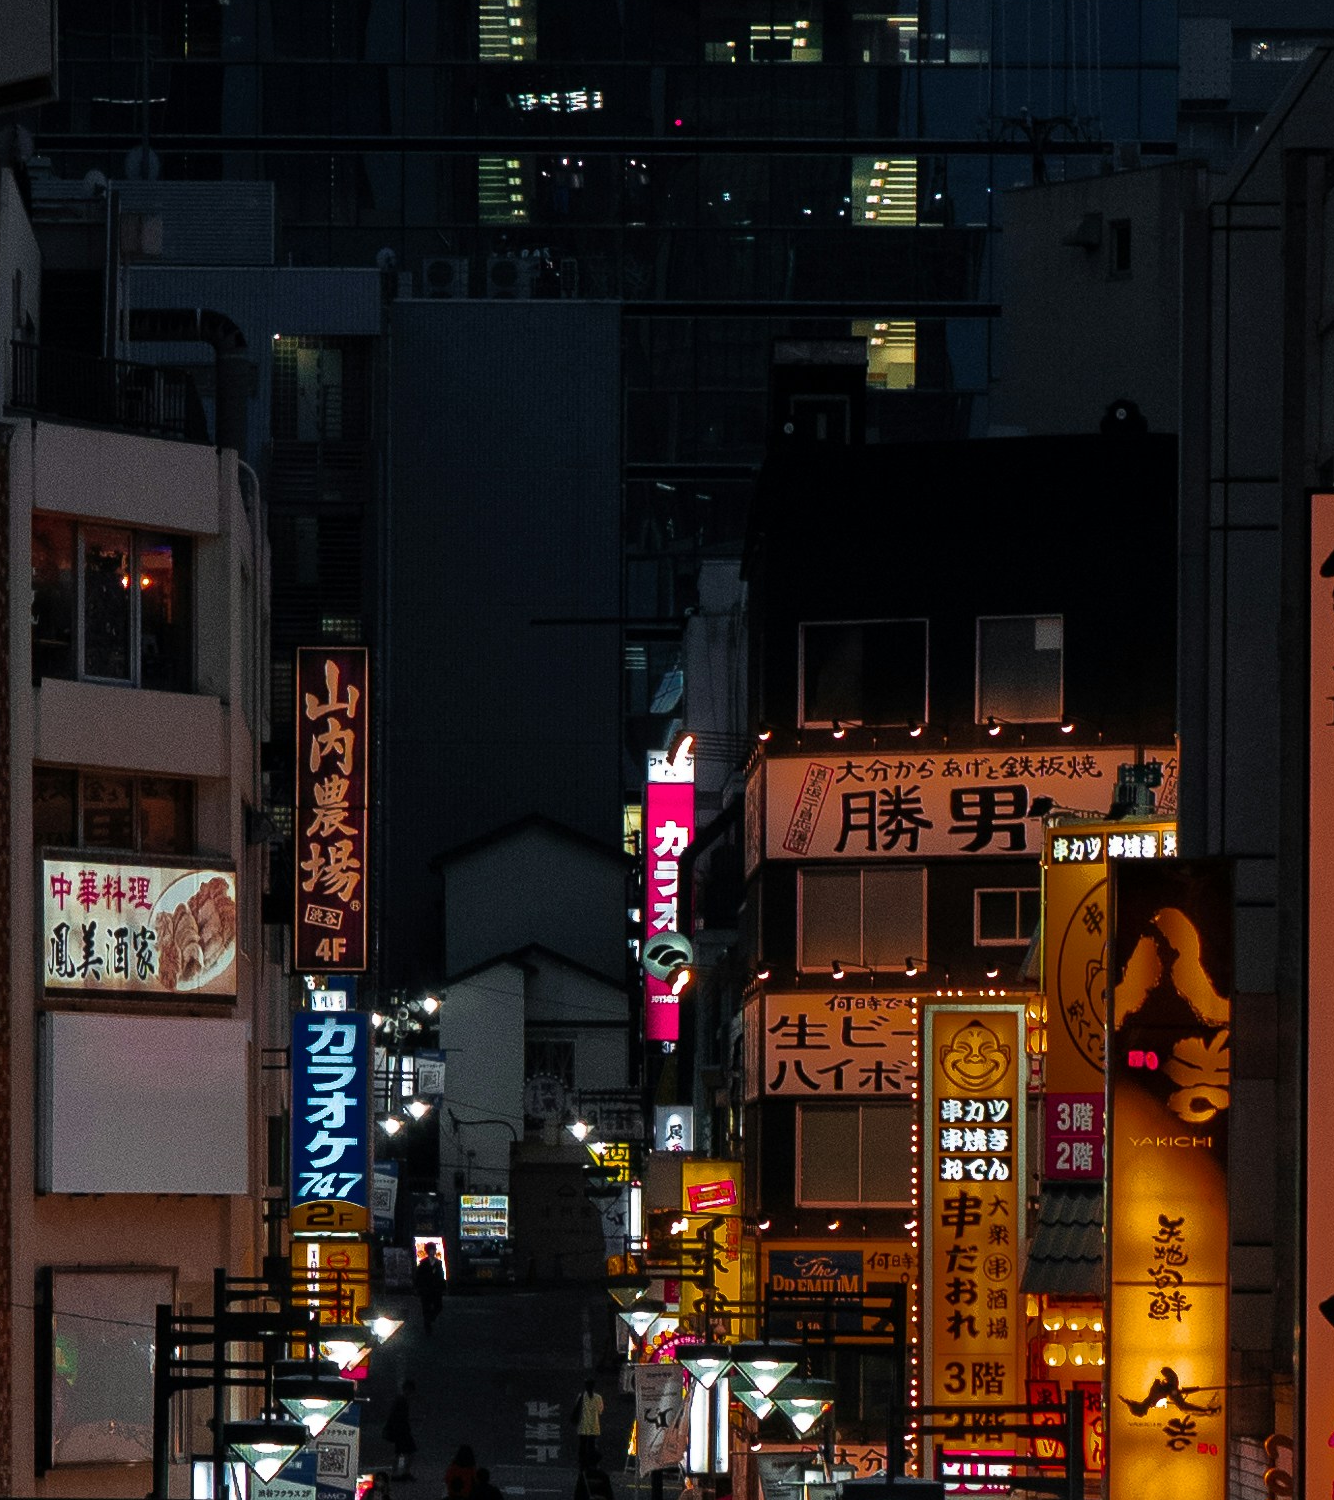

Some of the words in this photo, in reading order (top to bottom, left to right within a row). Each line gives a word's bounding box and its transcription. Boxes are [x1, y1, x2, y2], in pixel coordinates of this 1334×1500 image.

[301, 659, 360, 902] 山内農場
[833, 783, 1030, 853] 勝男
[1052, 837, 1101, 862] 串カツ
[50, 870, 153, 914] 中華料理
[316, 937, 346, 962] 4F
[305, 1017, 358, 1169] カラオケ
[940, 1098, 1009, 1123] 串カツ
[1056, 1102, 1095, 1133] 3階
[940, 1127, 1009, 1152] 串焼き
[1128, 1136, 1213, 1149] YAKICHI
[940, 1156, 1009, 1182] おでん
[1055, 1142, 1095, 1172] 2階
[297, 1172, 363, 1198] 747
[306, 1203, 354, 1227] 2F
[940, 1190, 983, 1341] 串だおれ
[943, 1361, 1006, 1395] 3階
